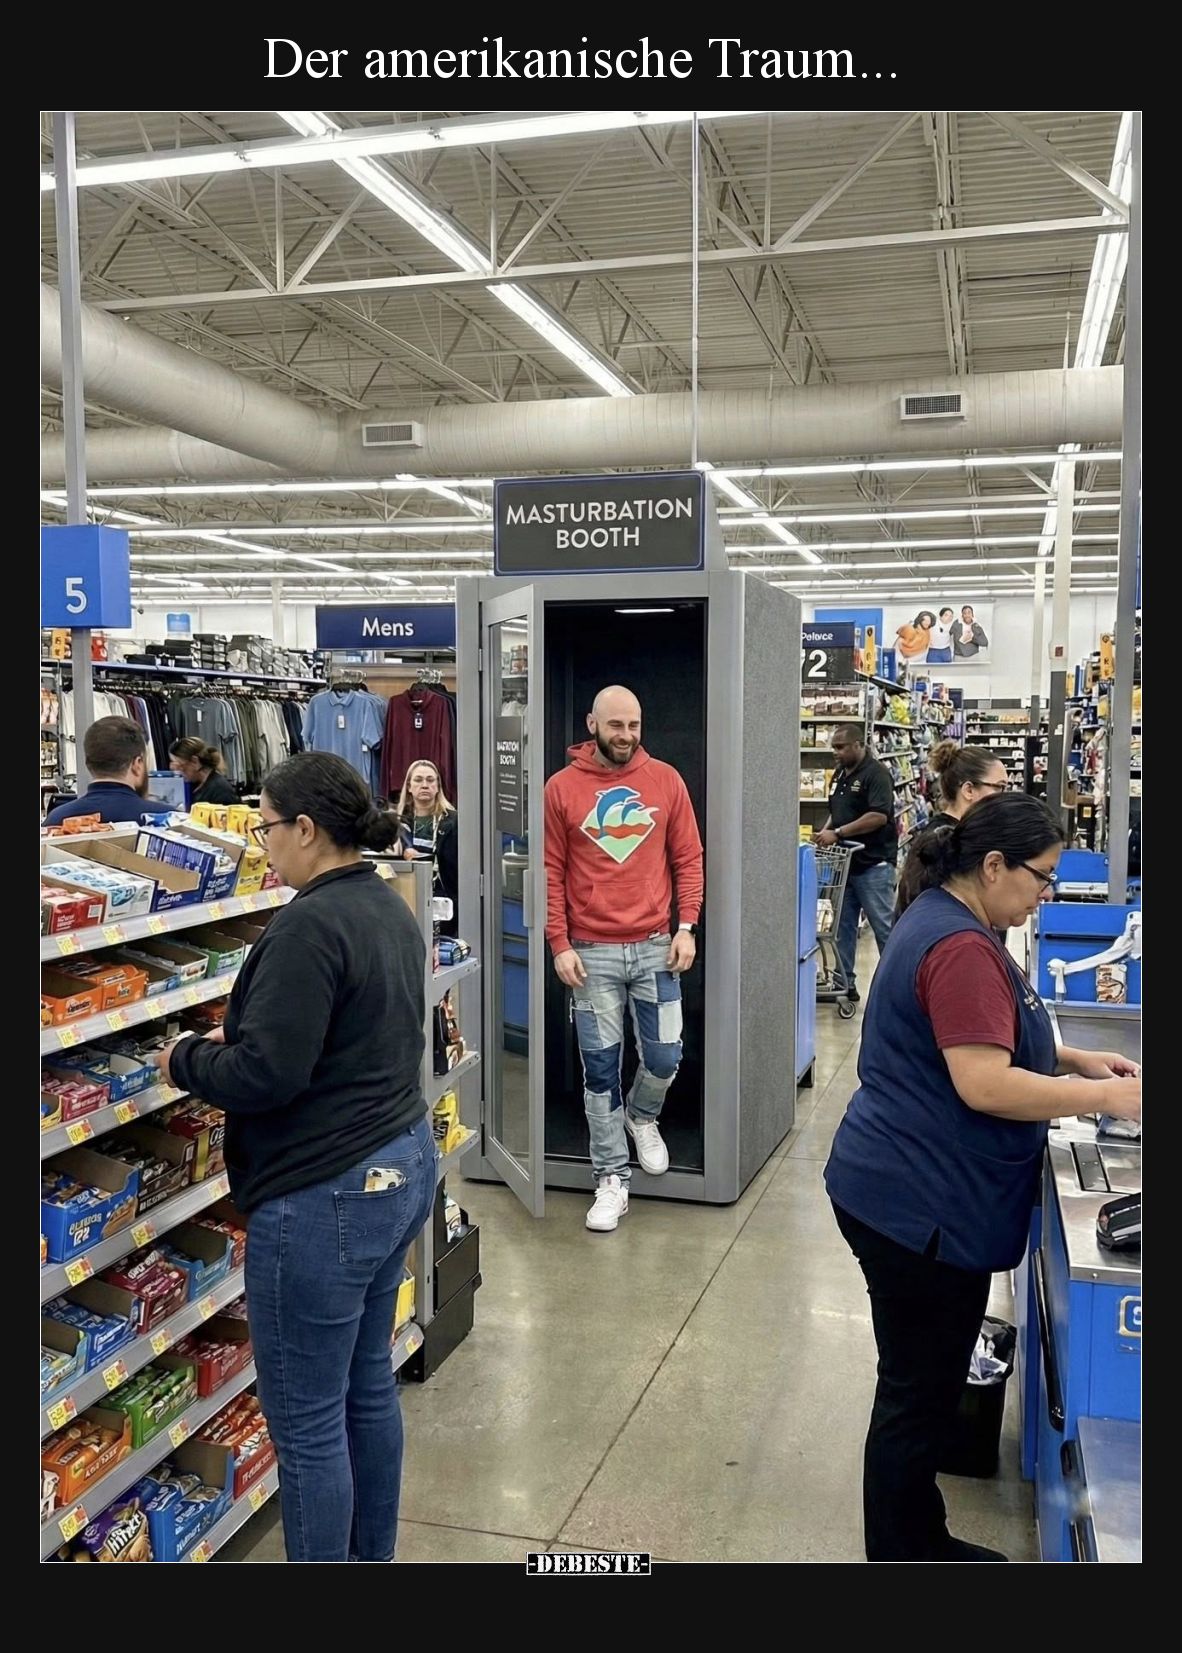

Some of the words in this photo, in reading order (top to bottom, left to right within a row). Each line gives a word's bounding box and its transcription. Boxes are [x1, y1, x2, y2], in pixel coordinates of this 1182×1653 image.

[507, 498, 691, 524] MASTURBATION
[557, 527, 639, 548] BOOTH
[66, 578, 86, 613] 5
[363, 617, 413, 636] Mens
